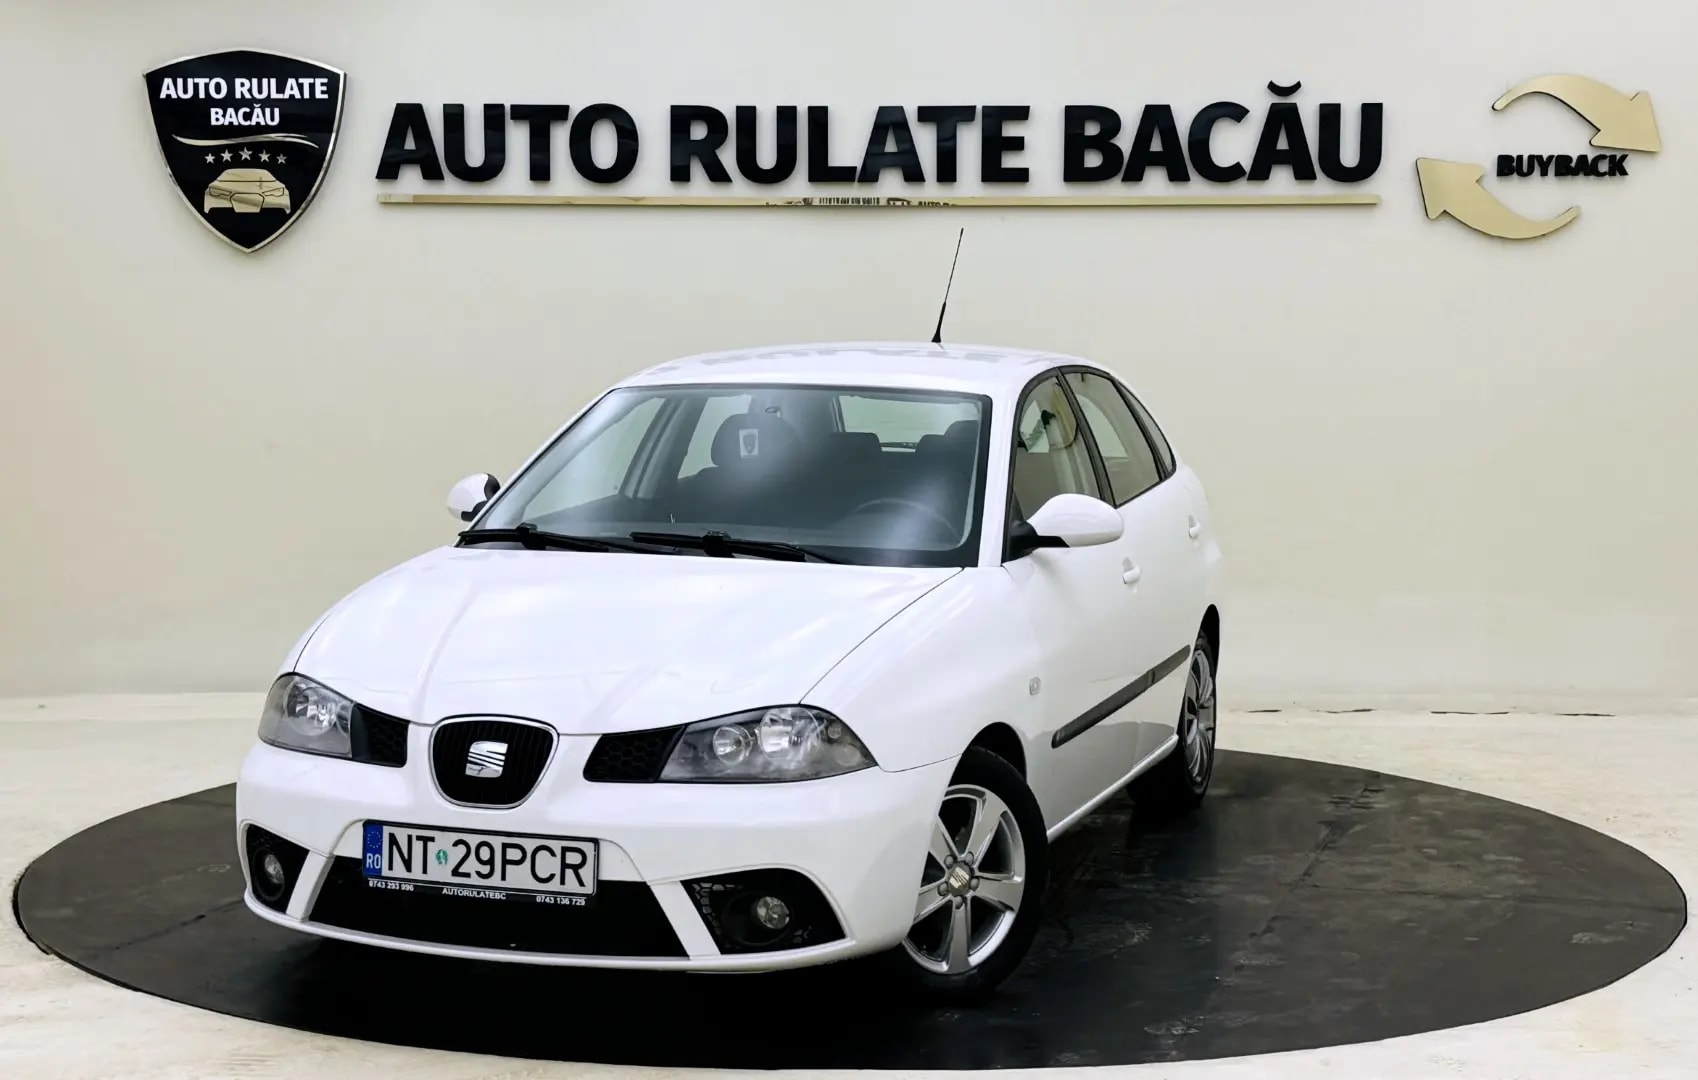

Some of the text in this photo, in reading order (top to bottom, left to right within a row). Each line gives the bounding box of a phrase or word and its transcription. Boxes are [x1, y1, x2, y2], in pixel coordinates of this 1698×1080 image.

[159, 77, 329, 99] AUTO RULATE
[210, 103, 280, 126] BACĂU
[375, 79, 1384, 184] AUTO RULATE BACĂU
[1496, 154, 1629, 178] BUYBACK
[366, 853, 382, 869] RO
[387, 832, 587, 888] NT 29PCR
[442, 887, 507, 900] AUTORULATEBC
[535, 895, 555, 904] 0743
